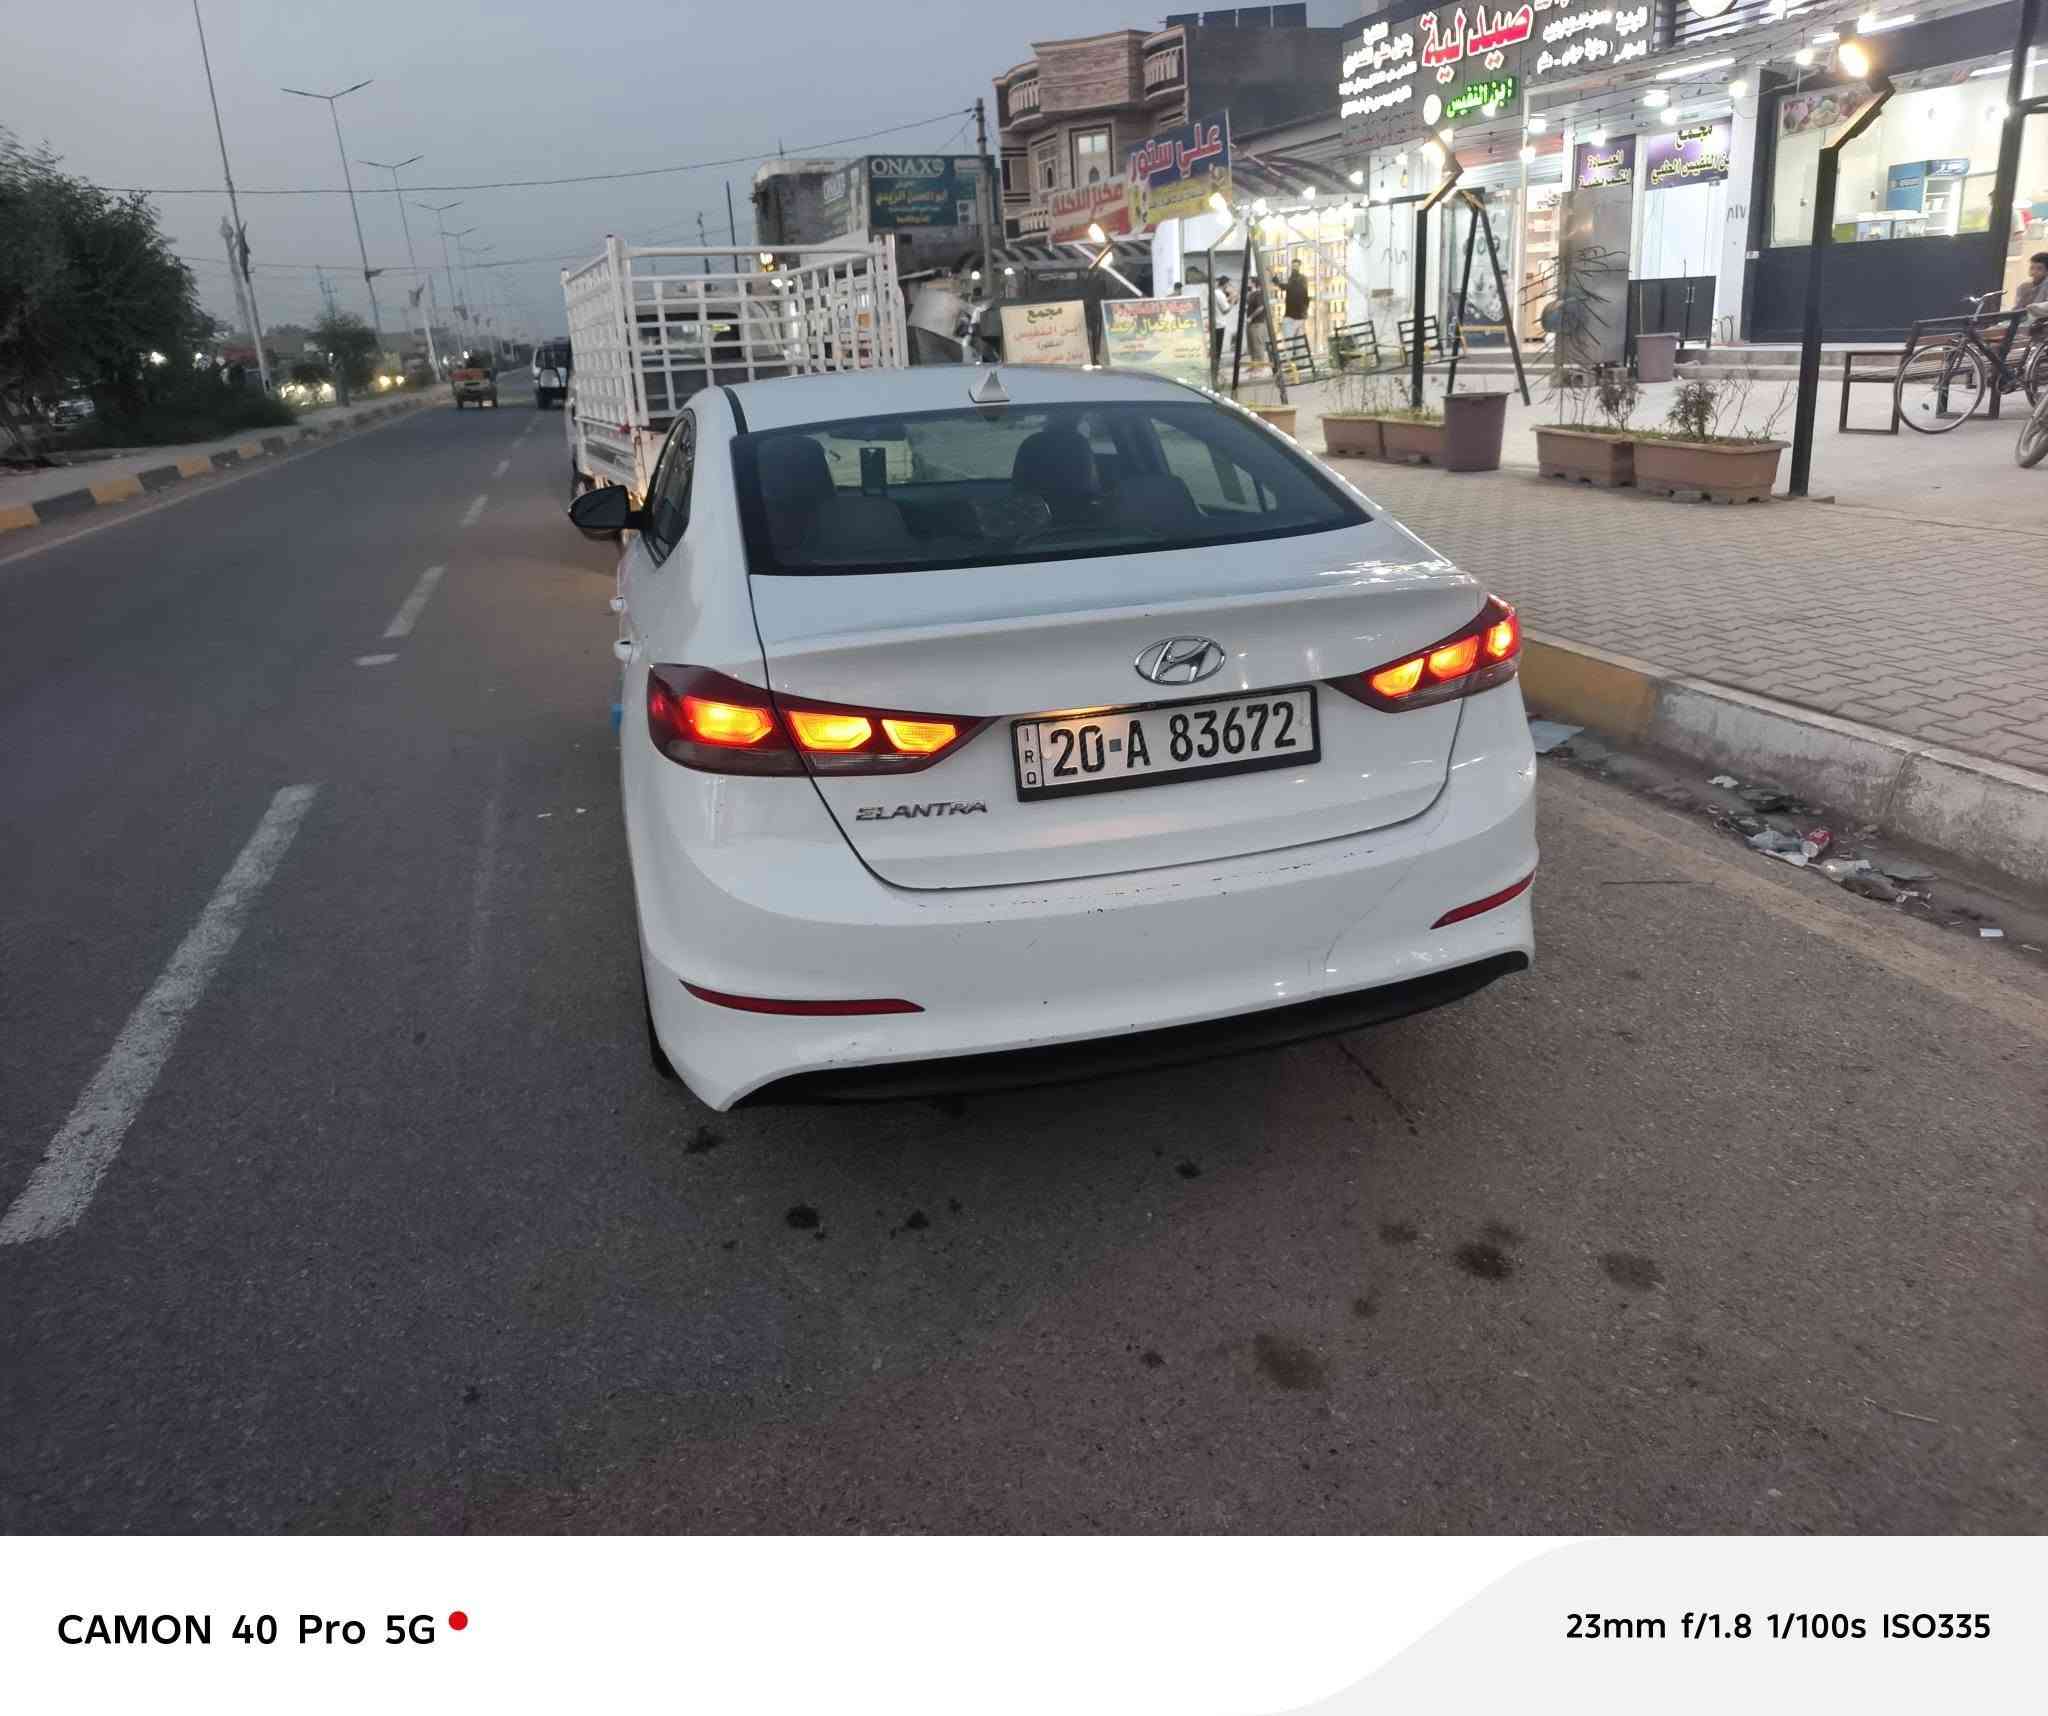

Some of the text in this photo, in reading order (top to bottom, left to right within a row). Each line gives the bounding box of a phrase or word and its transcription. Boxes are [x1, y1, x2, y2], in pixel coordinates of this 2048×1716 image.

[1420, 4, 1534, 84] صيدلية
[1446, 83, 1488, 118] النفيس
[1674, 124, 1713, 150] مجمع
[1127, 122, 1224, 183] علي ستور
[1681, 153, 1718, 177] النفيس
[1651, 157, 1681, 185] الطبي
[1026, 307, 1062, 324] مجمع
[1169, 701, 1297, 762] 83672
[856, 800, 988, 821] ELANTRA
